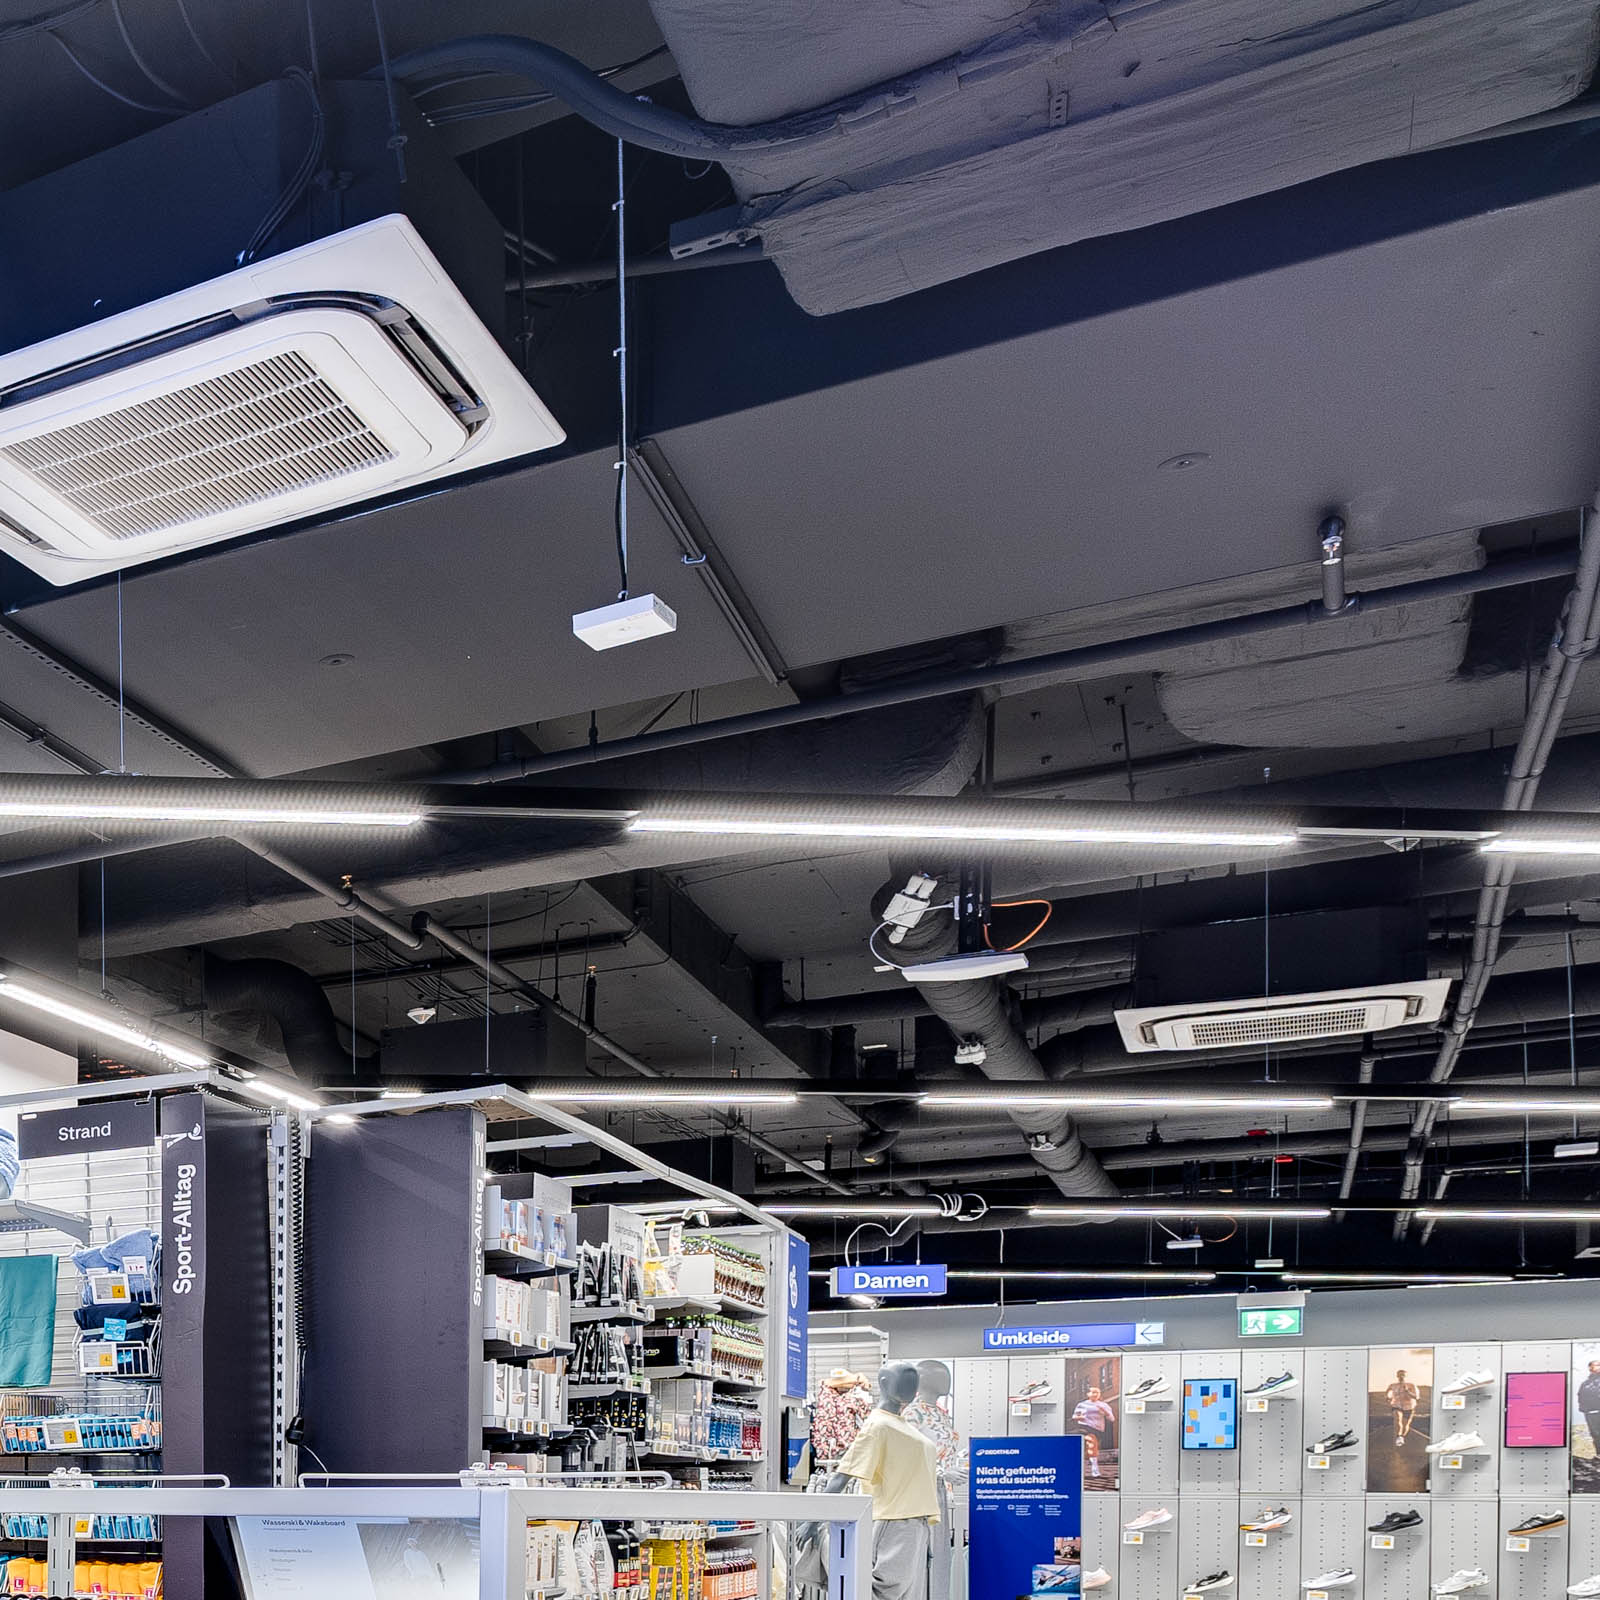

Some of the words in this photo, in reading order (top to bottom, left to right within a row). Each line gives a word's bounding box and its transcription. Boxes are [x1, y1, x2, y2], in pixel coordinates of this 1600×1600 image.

[58, 1121, 112, 1141] Strand
[172, 1164, 197, 1295] Sport-Alltag
[473, 1179, 485, 1307] Sport-Alltag
[854, 1272, 929, 1289] Damen
[989, 1330, 1071, 1346] Umkleide
[976, 1467, 1005, 1475] Nicht
[1005, 1466, 1056, 1476] gefunden
[999, 1475, 1013, 1484] du
[1014, 1475, 1056, 1484] suchst?
[262, 1519, 298, 1527] Wasserski
[305, 1519, 346, 1527] Wakeboard
